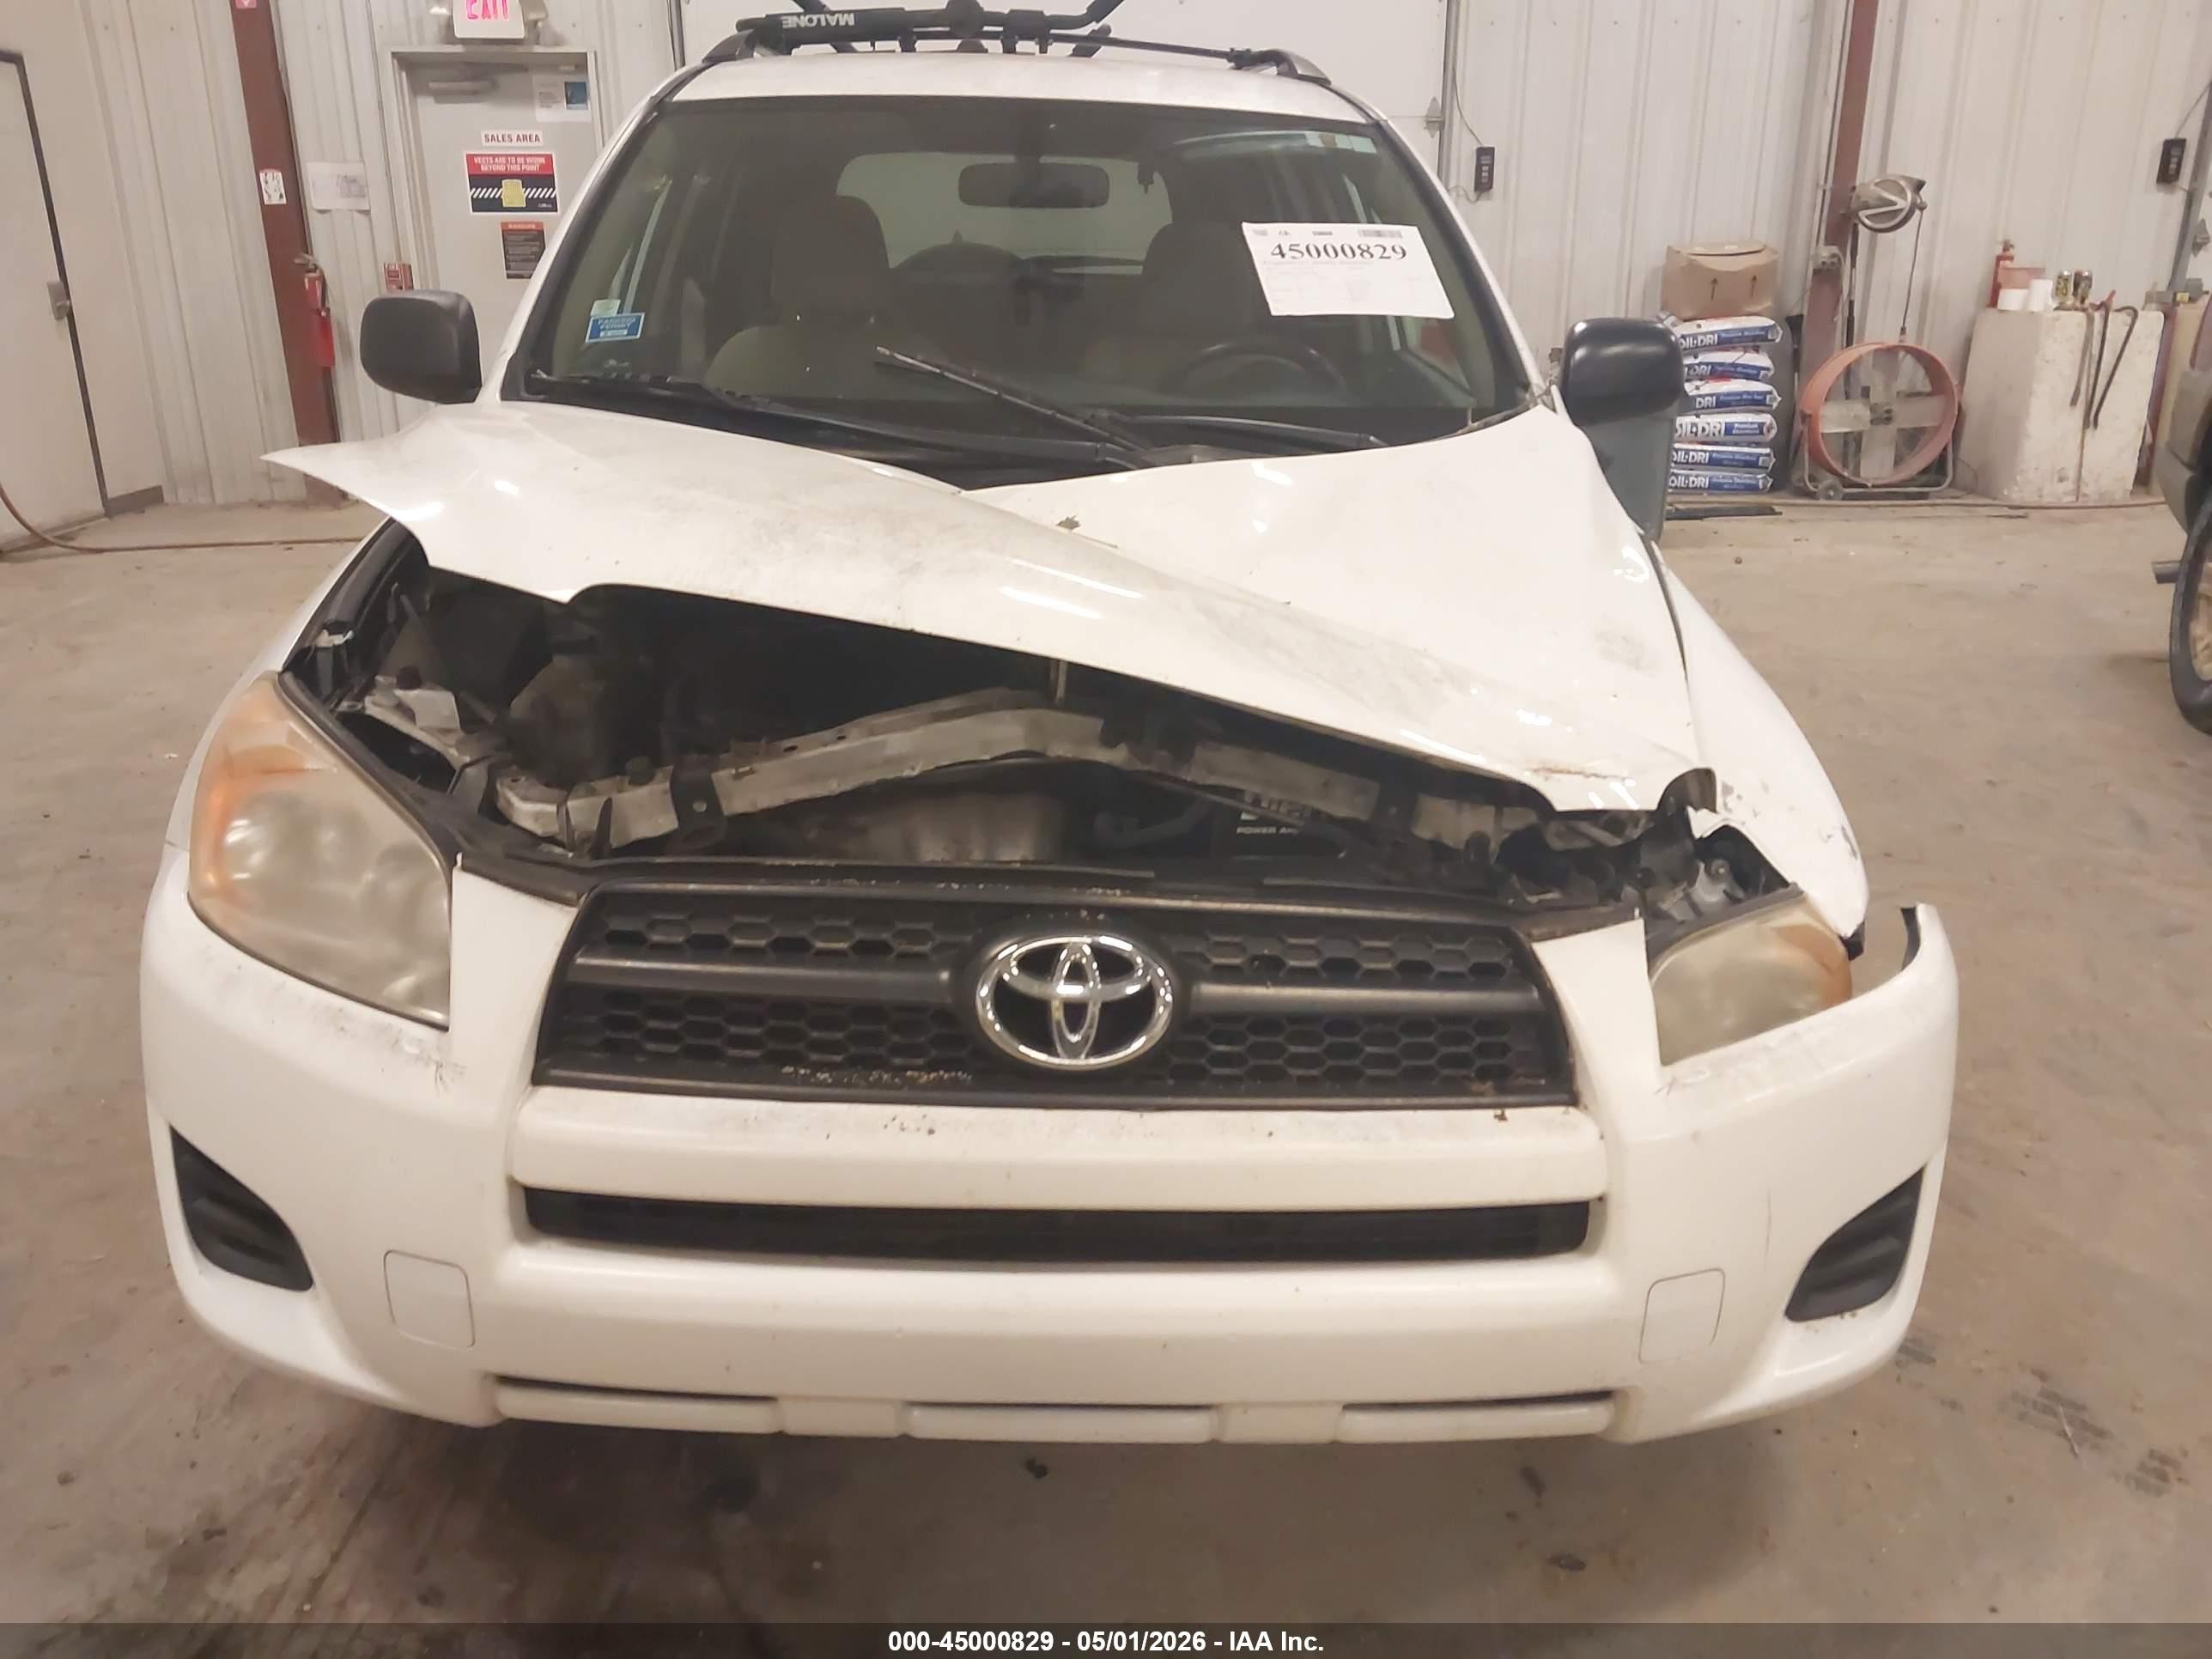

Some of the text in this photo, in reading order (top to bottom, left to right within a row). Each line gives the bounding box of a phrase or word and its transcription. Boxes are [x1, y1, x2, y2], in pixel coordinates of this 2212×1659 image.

[782, 13, 854, 27] MALONE
[484, 134, 540, 143] SALES AREA
[1271, 243, 1407, 260] 45000829
